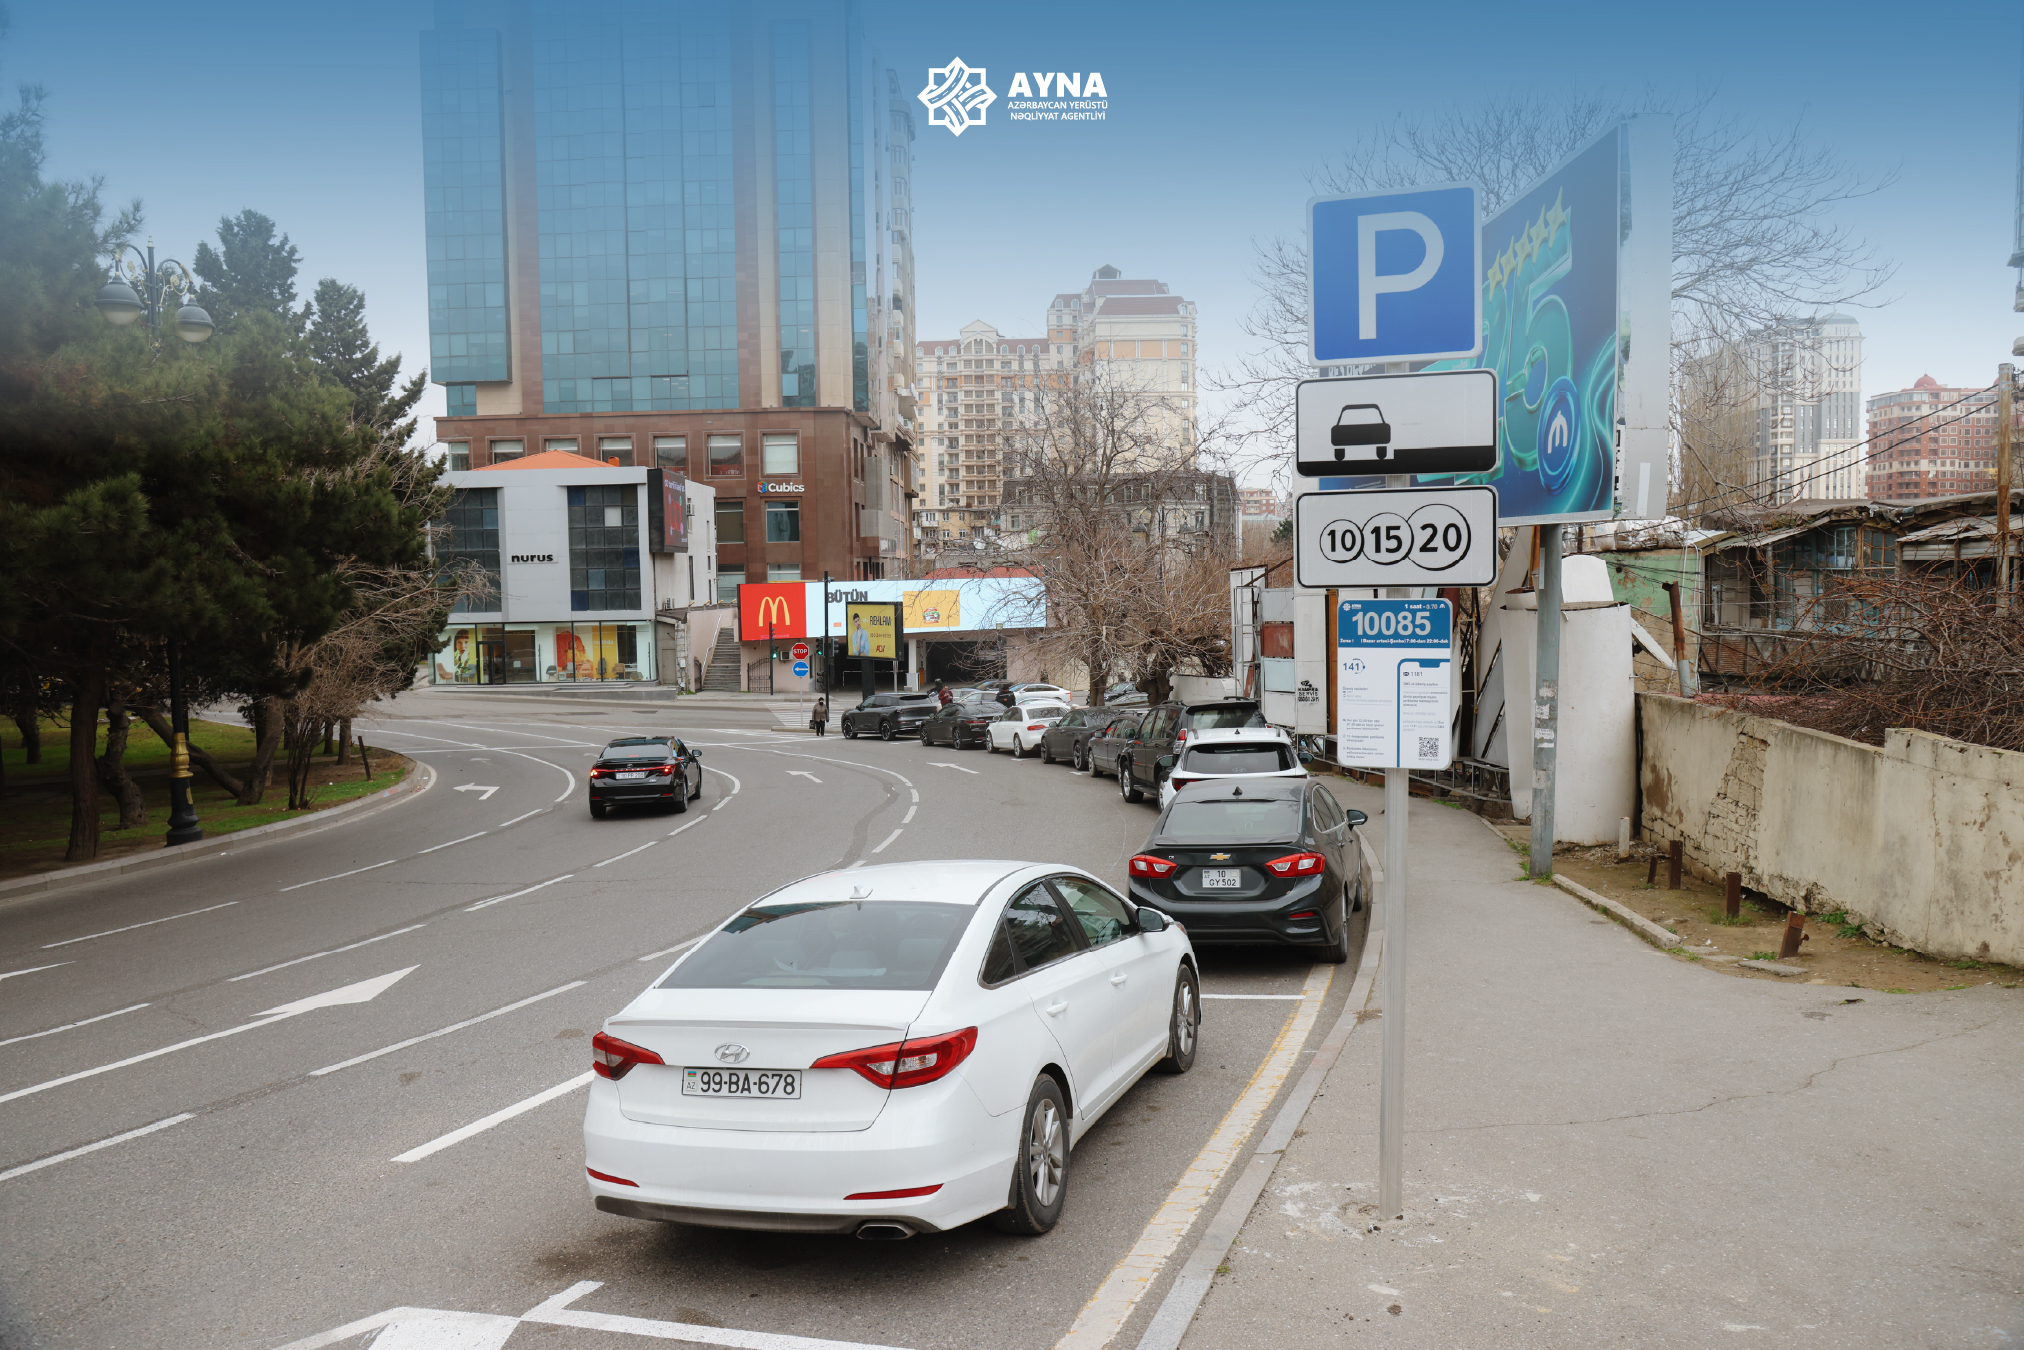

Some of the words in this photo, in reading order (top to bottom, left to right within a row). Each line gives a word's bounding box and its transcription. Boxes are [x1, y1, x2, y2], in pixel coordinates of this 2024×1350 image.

[1358, 211, 1445, 341] P
[768, 482, 805, 492] Cubics
[1327, 529, 1357, 553] 10
[1371, 526, 1403, 554] 15
[1420, 523, 1462, 553] 20
[511, 554, 554, 563] nurus
[828, 588, 868, 603] BÜTÜN
[869, 615, 892, 626] REKLAM
[1352, 611, 1431, 636] 10085
[1342, 662, 1359, 671] 141
[1217, 870, 1226, 878] 10
[1209, 878, 1220, 887] GY
[1221, 878, 1237, 887] 502
[686, 1082, 696, 1090] AZ
[700, 1071, 795, 1096] 99-BA-678
